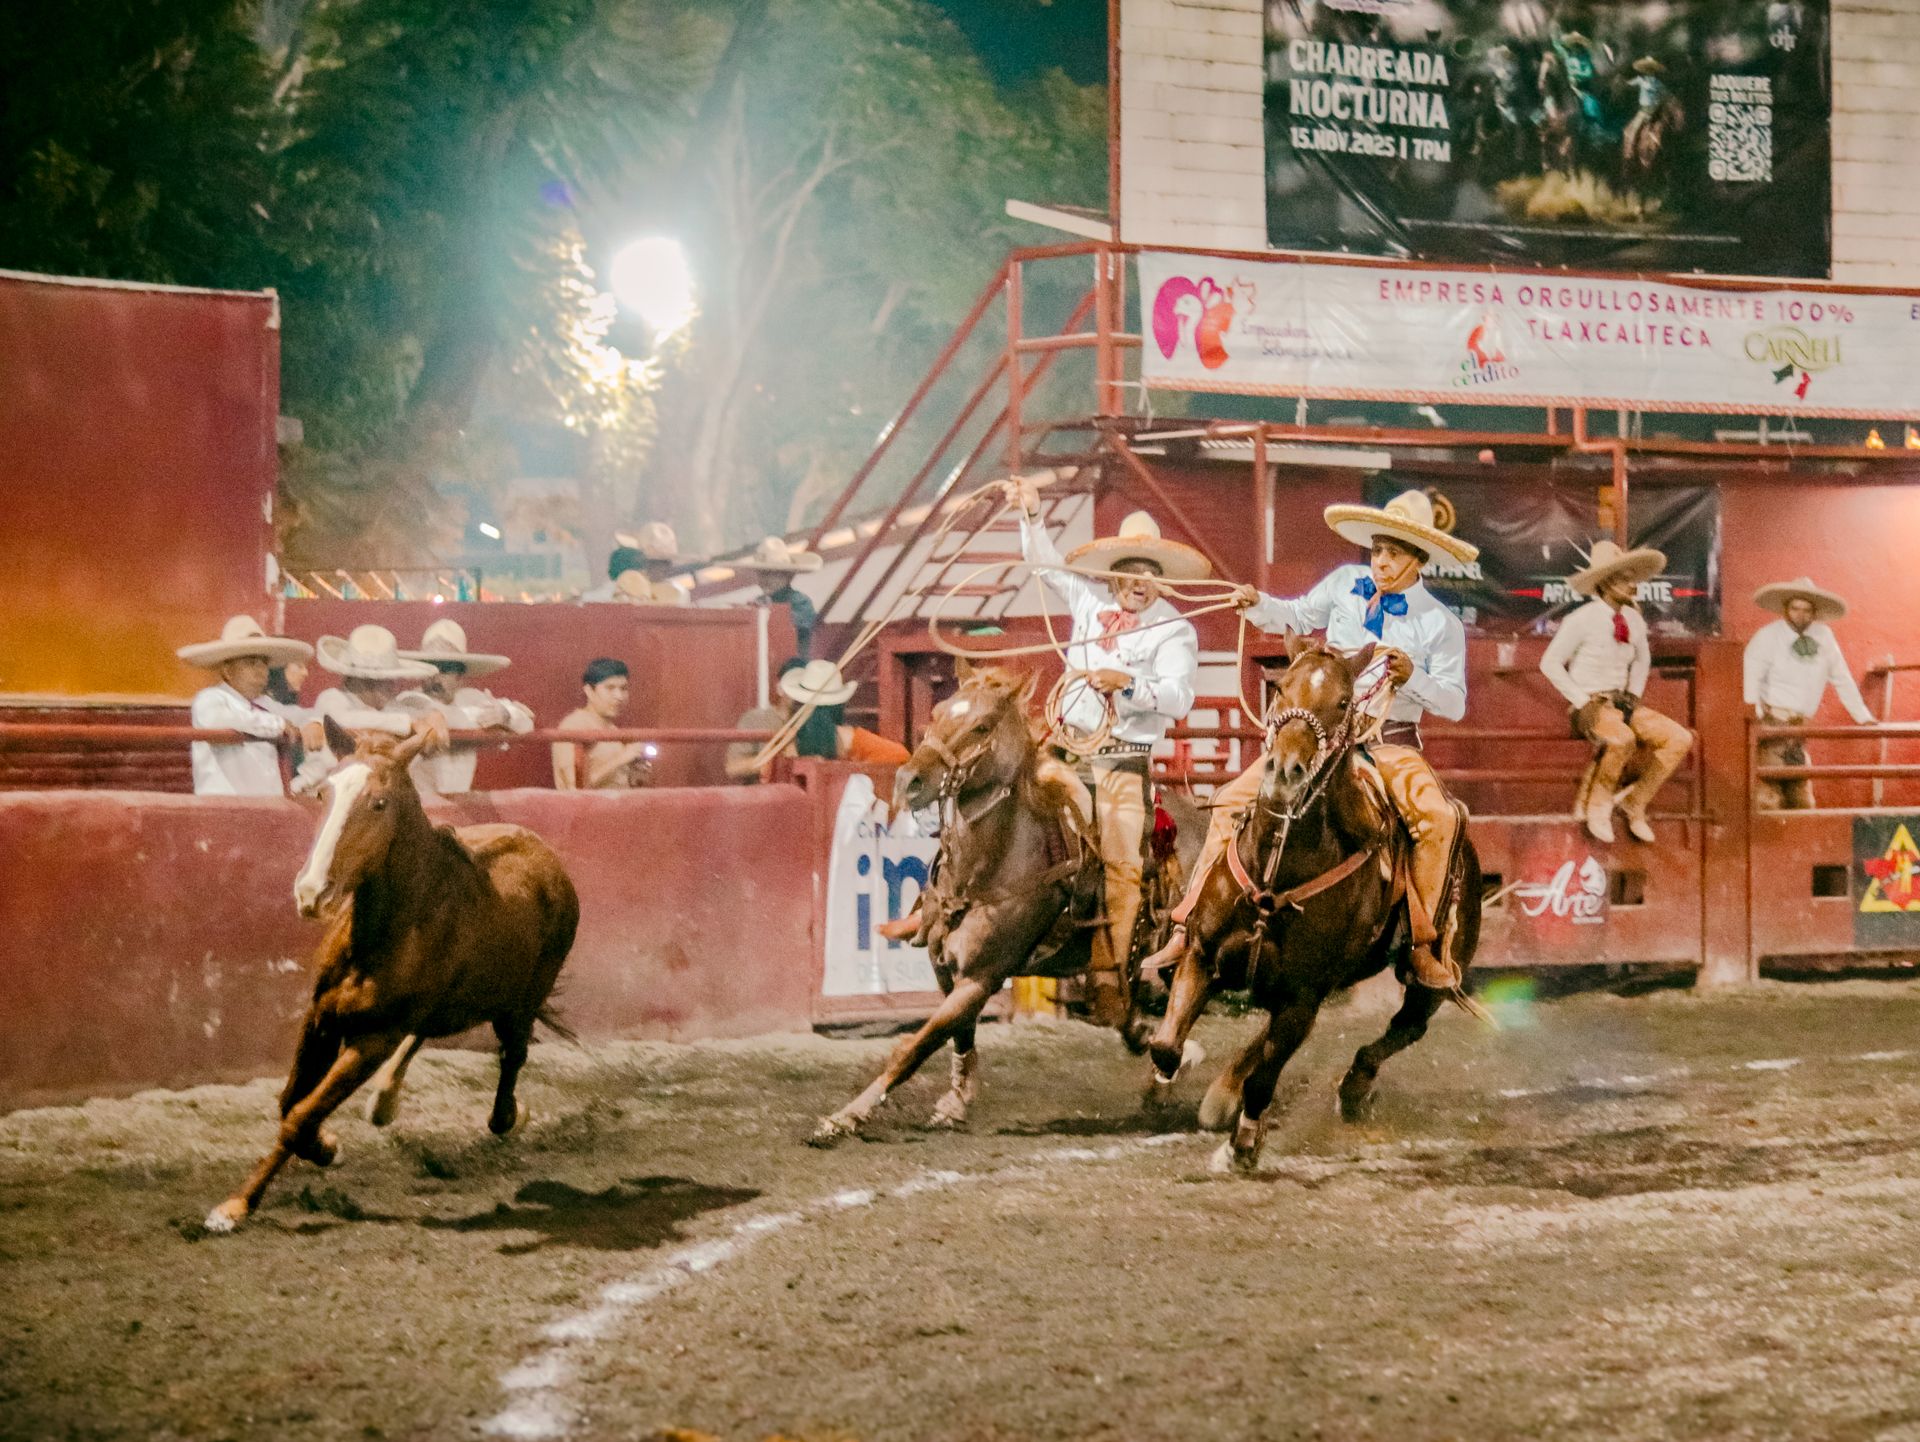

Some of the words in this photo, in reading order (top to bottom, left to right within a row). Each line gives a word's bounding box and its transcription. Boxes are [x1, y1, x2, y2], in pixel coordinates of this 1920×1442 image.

[1289, 39, 1449, 86] CHARREADA
[1289, 78, 1449, 130] NOCTURNA
[1412, 138, 1451, 162] 7PM
[1379, 279, 1504, 305] EMPRESA
[1517, 285, 1764, 320] ORGULLOSAMENTE
[1778, 301, 1854, 323] 100%
[1527, 319, 1712, 347] TLAXCALTECA
